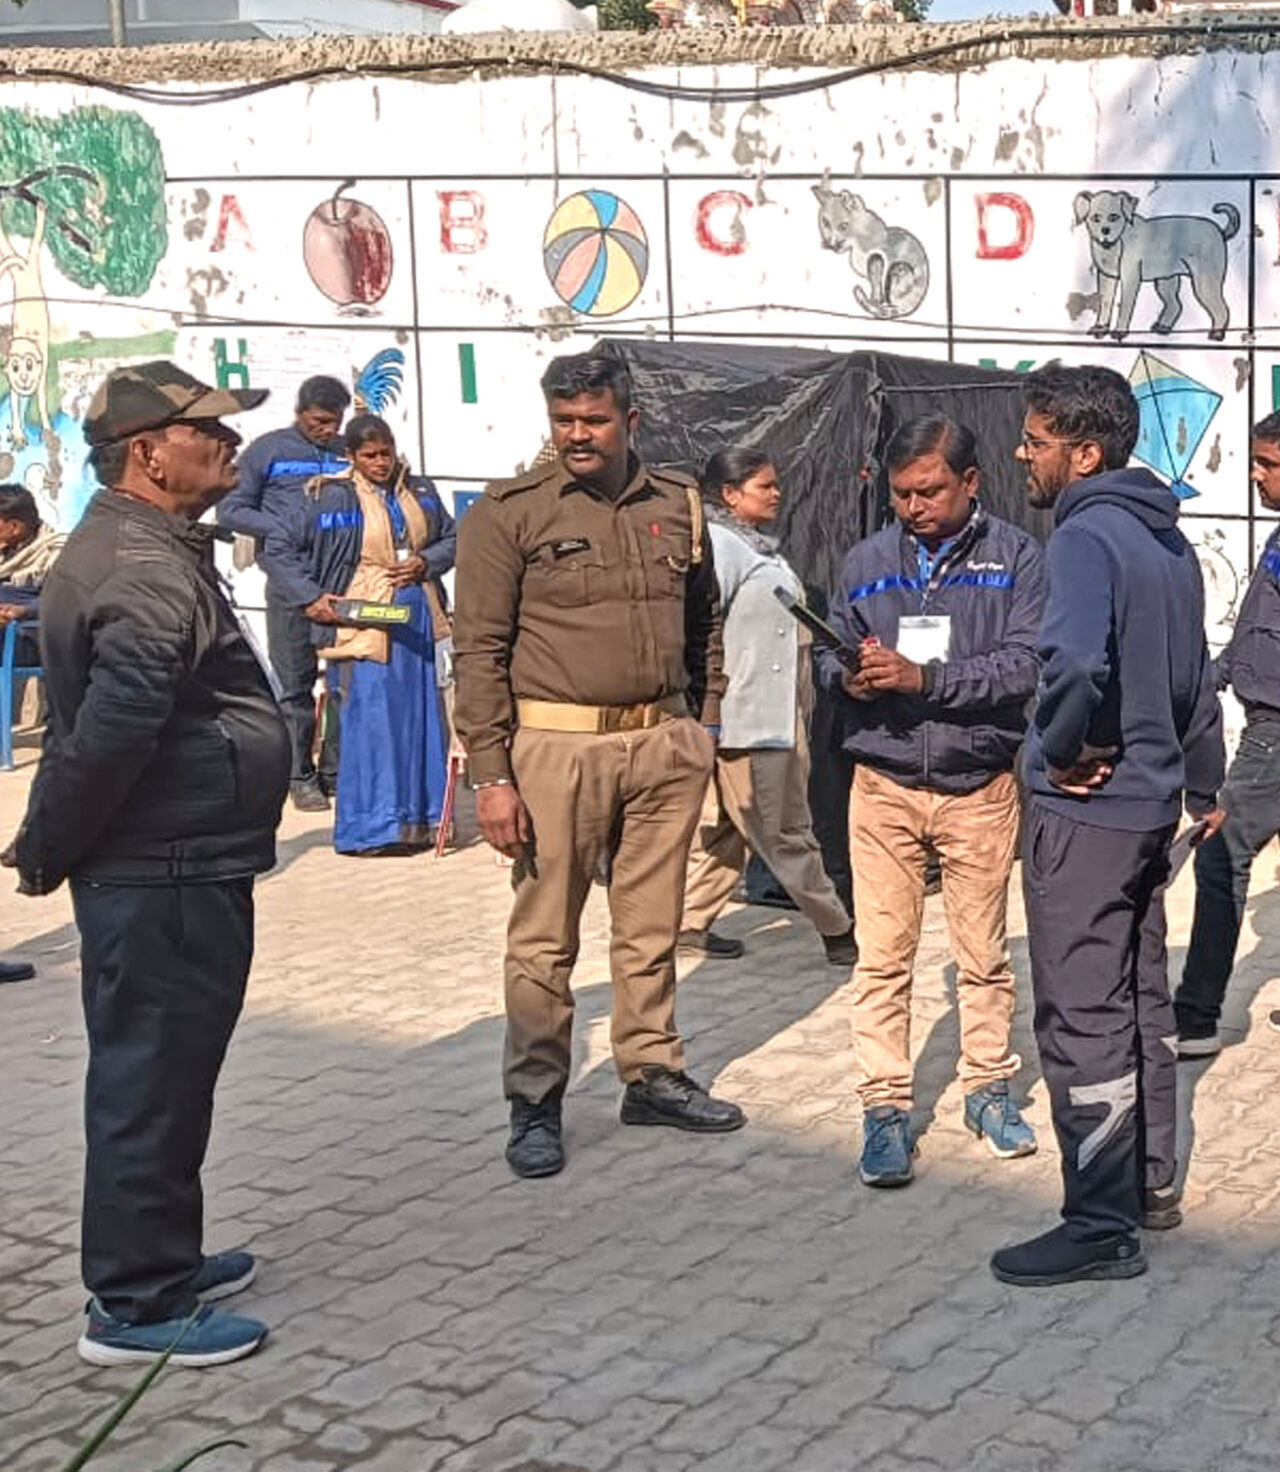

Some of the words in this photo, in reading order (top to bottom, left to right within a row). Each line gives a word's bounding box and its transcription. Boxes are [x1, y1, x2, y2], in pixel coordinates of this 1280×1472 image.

[209, 194, 257, 252] A
[437, 190, 487, 253] B
[695, 191, 754, 257] C
[975, 192, 1036, 261] D
[213, 338, 250, 390] H
[459, 343, 478, 404] I
